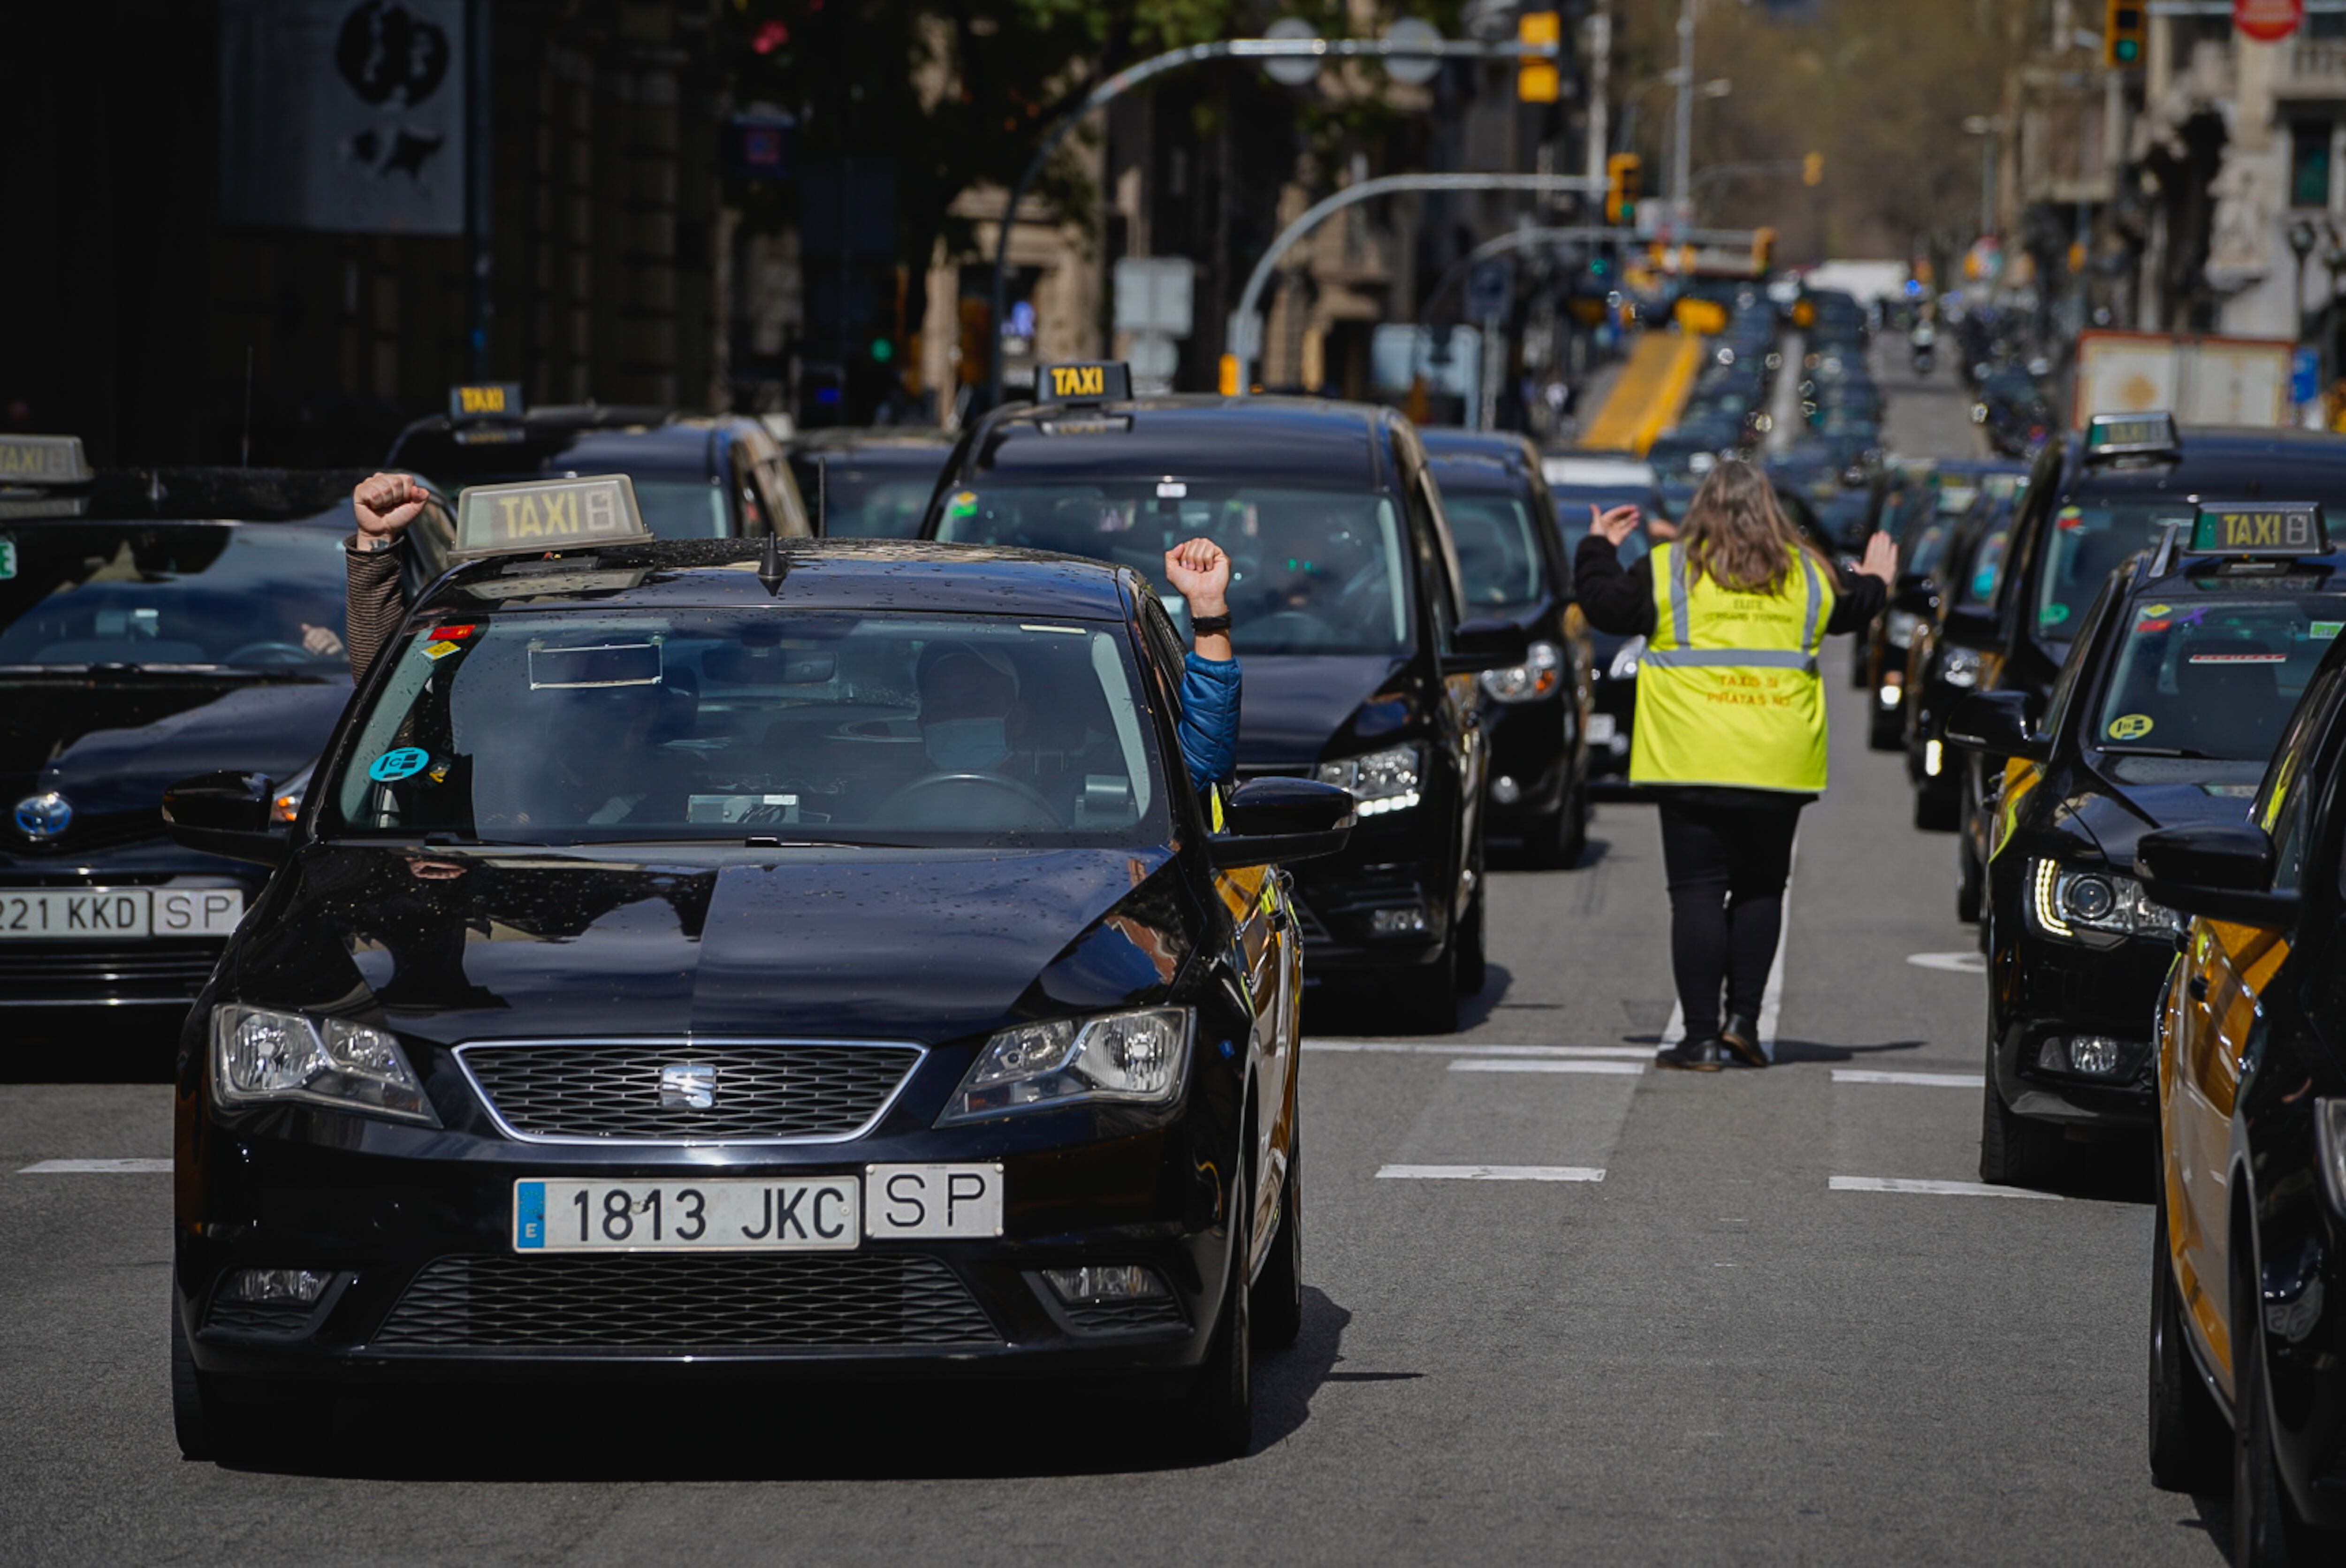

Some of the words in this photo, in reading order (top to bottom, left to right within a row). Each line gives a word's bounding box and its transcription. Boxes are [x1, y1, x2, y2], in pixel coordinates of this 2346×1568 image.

[1051, 366, 1104, 396] TAXI
[459, 387, 504, 413] TAXI
[499, 491, 579, 540] TAXI
[2223, 514, 2281, 545] TAXI
[1707, 692, 1766, 705] PIRATAS
[0, 897, 47, 930] 21
[68, 897, 136, 929] KKD
[525, 1223, 537, 1238] E
[574, 1188, 707, 1243] 1813
[741, 1187, 845, 1241] JKC
